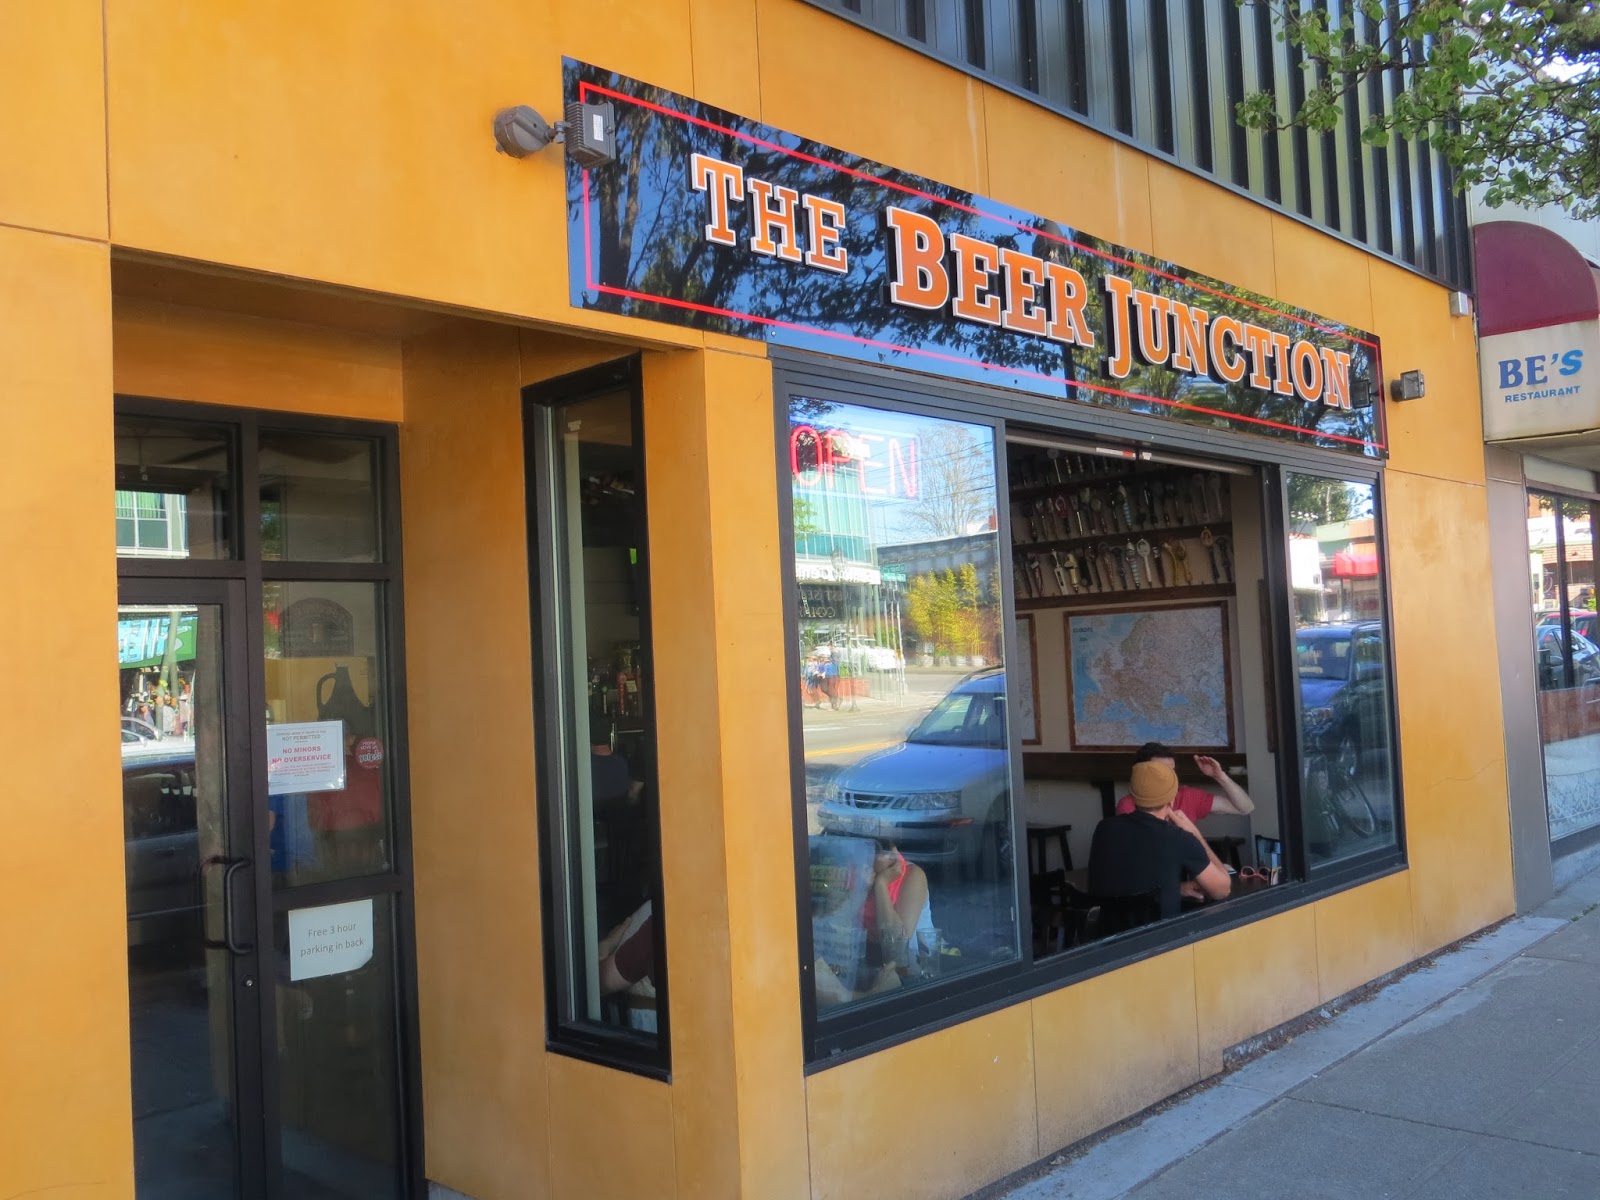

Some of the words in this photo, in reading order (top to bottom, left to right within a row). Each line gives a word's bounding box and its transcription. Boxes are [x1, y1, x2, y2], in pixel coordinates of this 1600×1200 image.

[690, 153, 848, 274] THE
[886, 205, 1095, 348] BEER
[1105, 273, 1352, 410] JUNCTION
[1498, 349, 1584, 389] BE'S
[1504, 385, 1581, 403] RESTAURANT
[790, 424, 918, 497] OPEN
[283, 753, 332, 763] OVERSERVICE
[293, 745, 321, 753] MINORS
[308, 928, 328, 938] Free
[330, 925, 335, 934] 3
[337, 923, 357, 933] hour
[300, 944, 334, 957] parking
[335, 941, 343, 950] in
[345, 937, 364, 948] back
